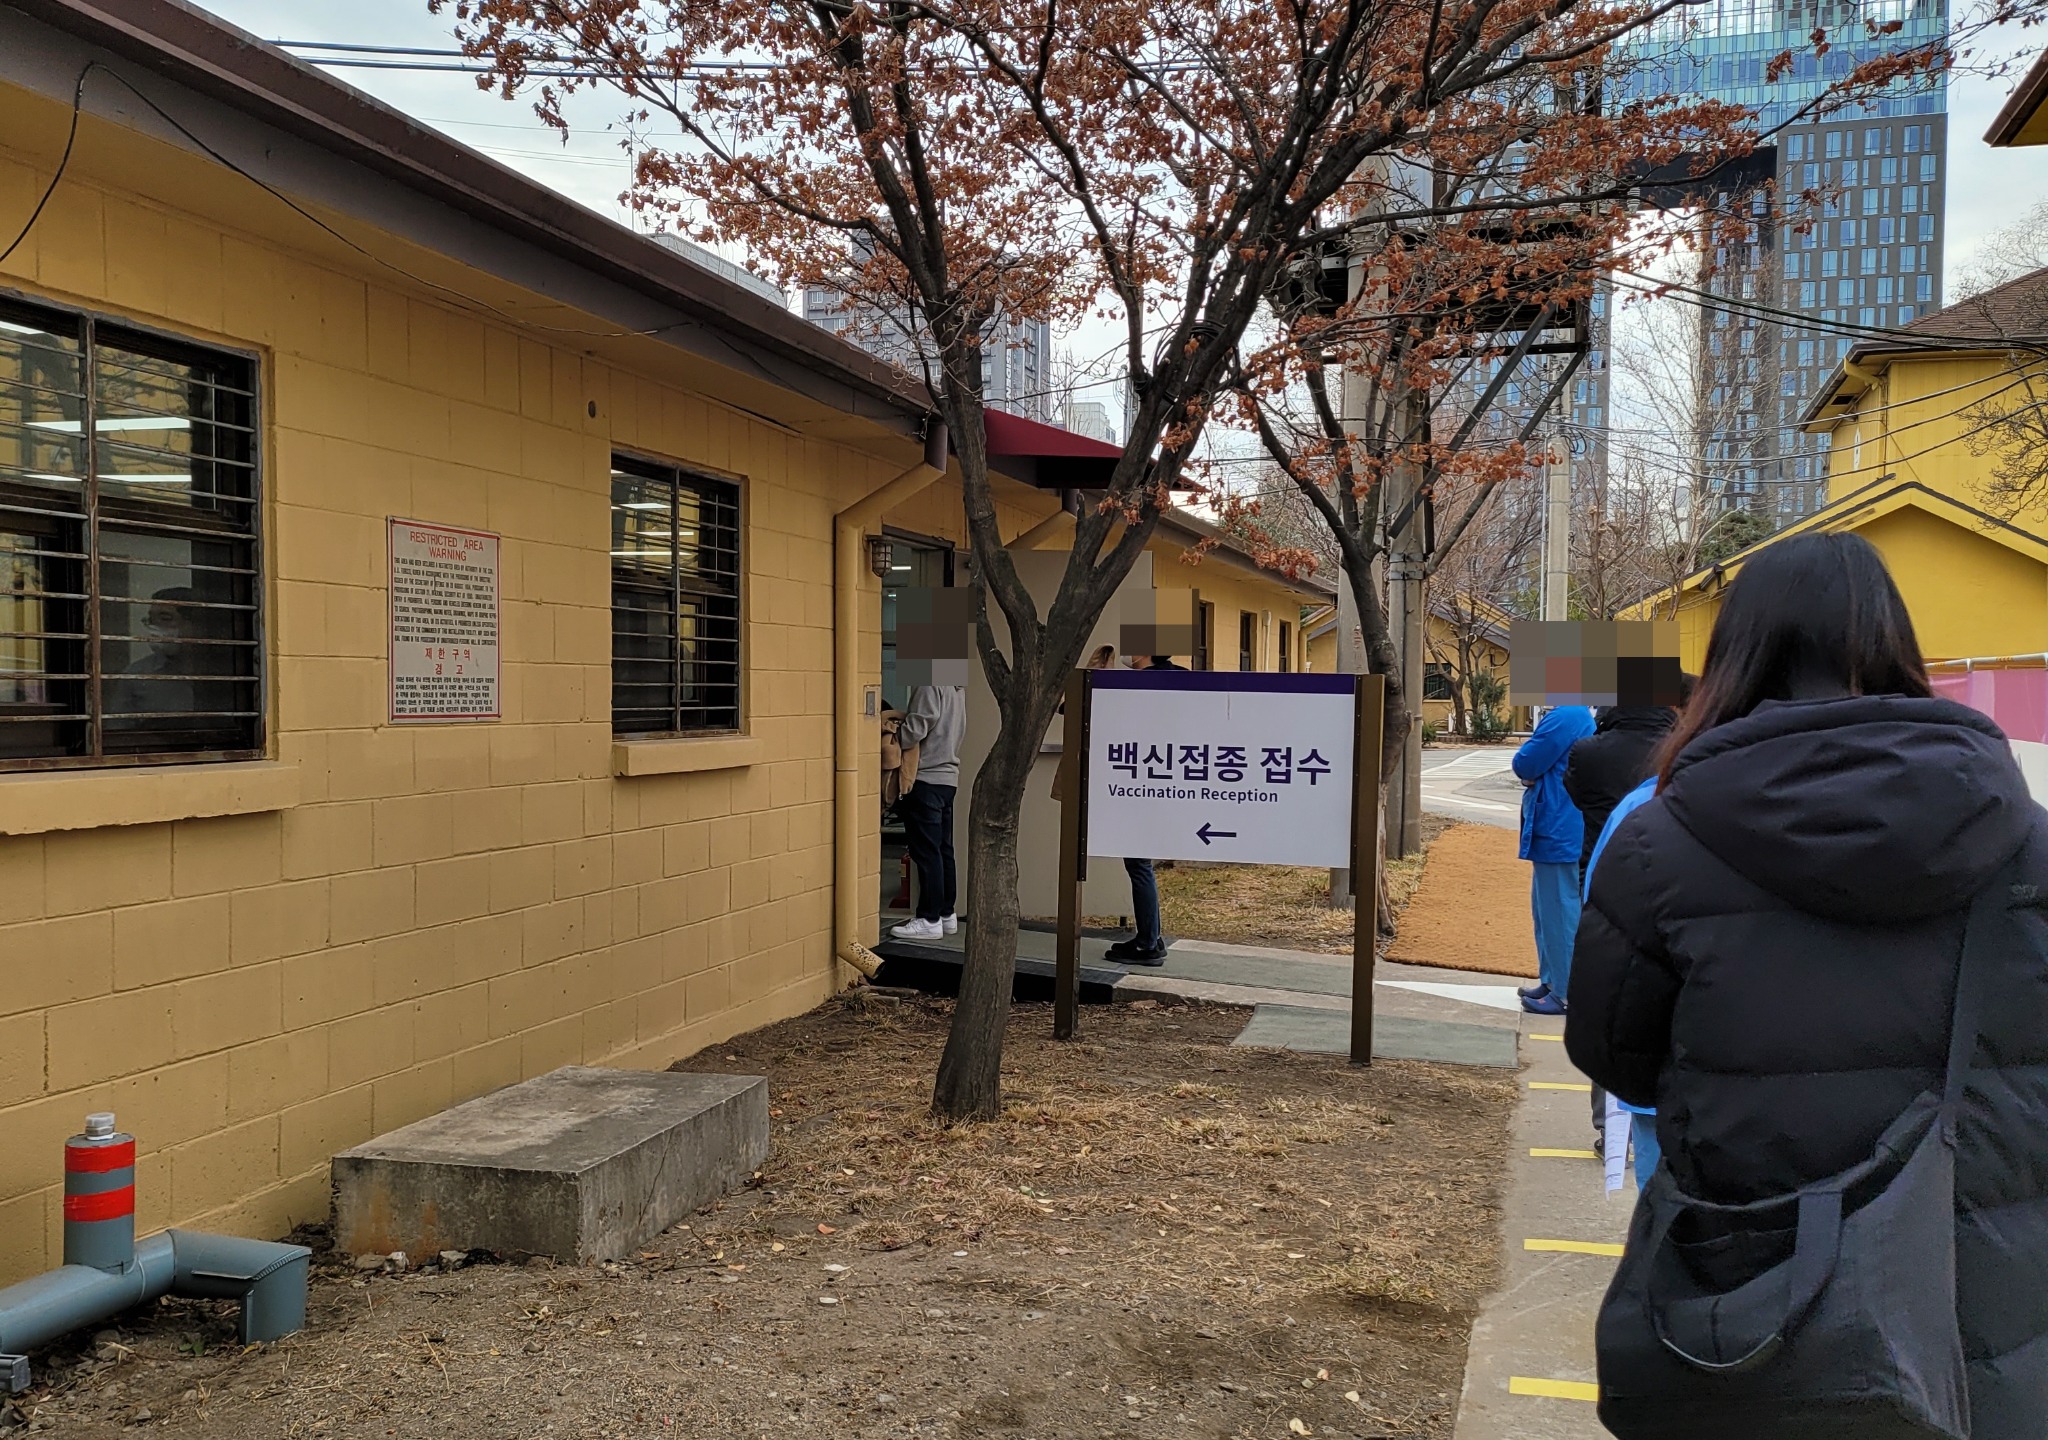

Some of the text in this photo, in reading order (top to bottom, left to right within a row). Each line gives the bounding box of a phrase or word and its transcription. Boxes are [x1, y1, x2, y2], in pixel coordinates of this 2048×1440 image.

[410, 531, 484, 551] RESTRICTED AREA
[429, 546, 467, 561] WARNING
[1107, 741, 1332, 786] 백신접종 접수
[1108, 783, 1278, 804] Vaccination Reception
